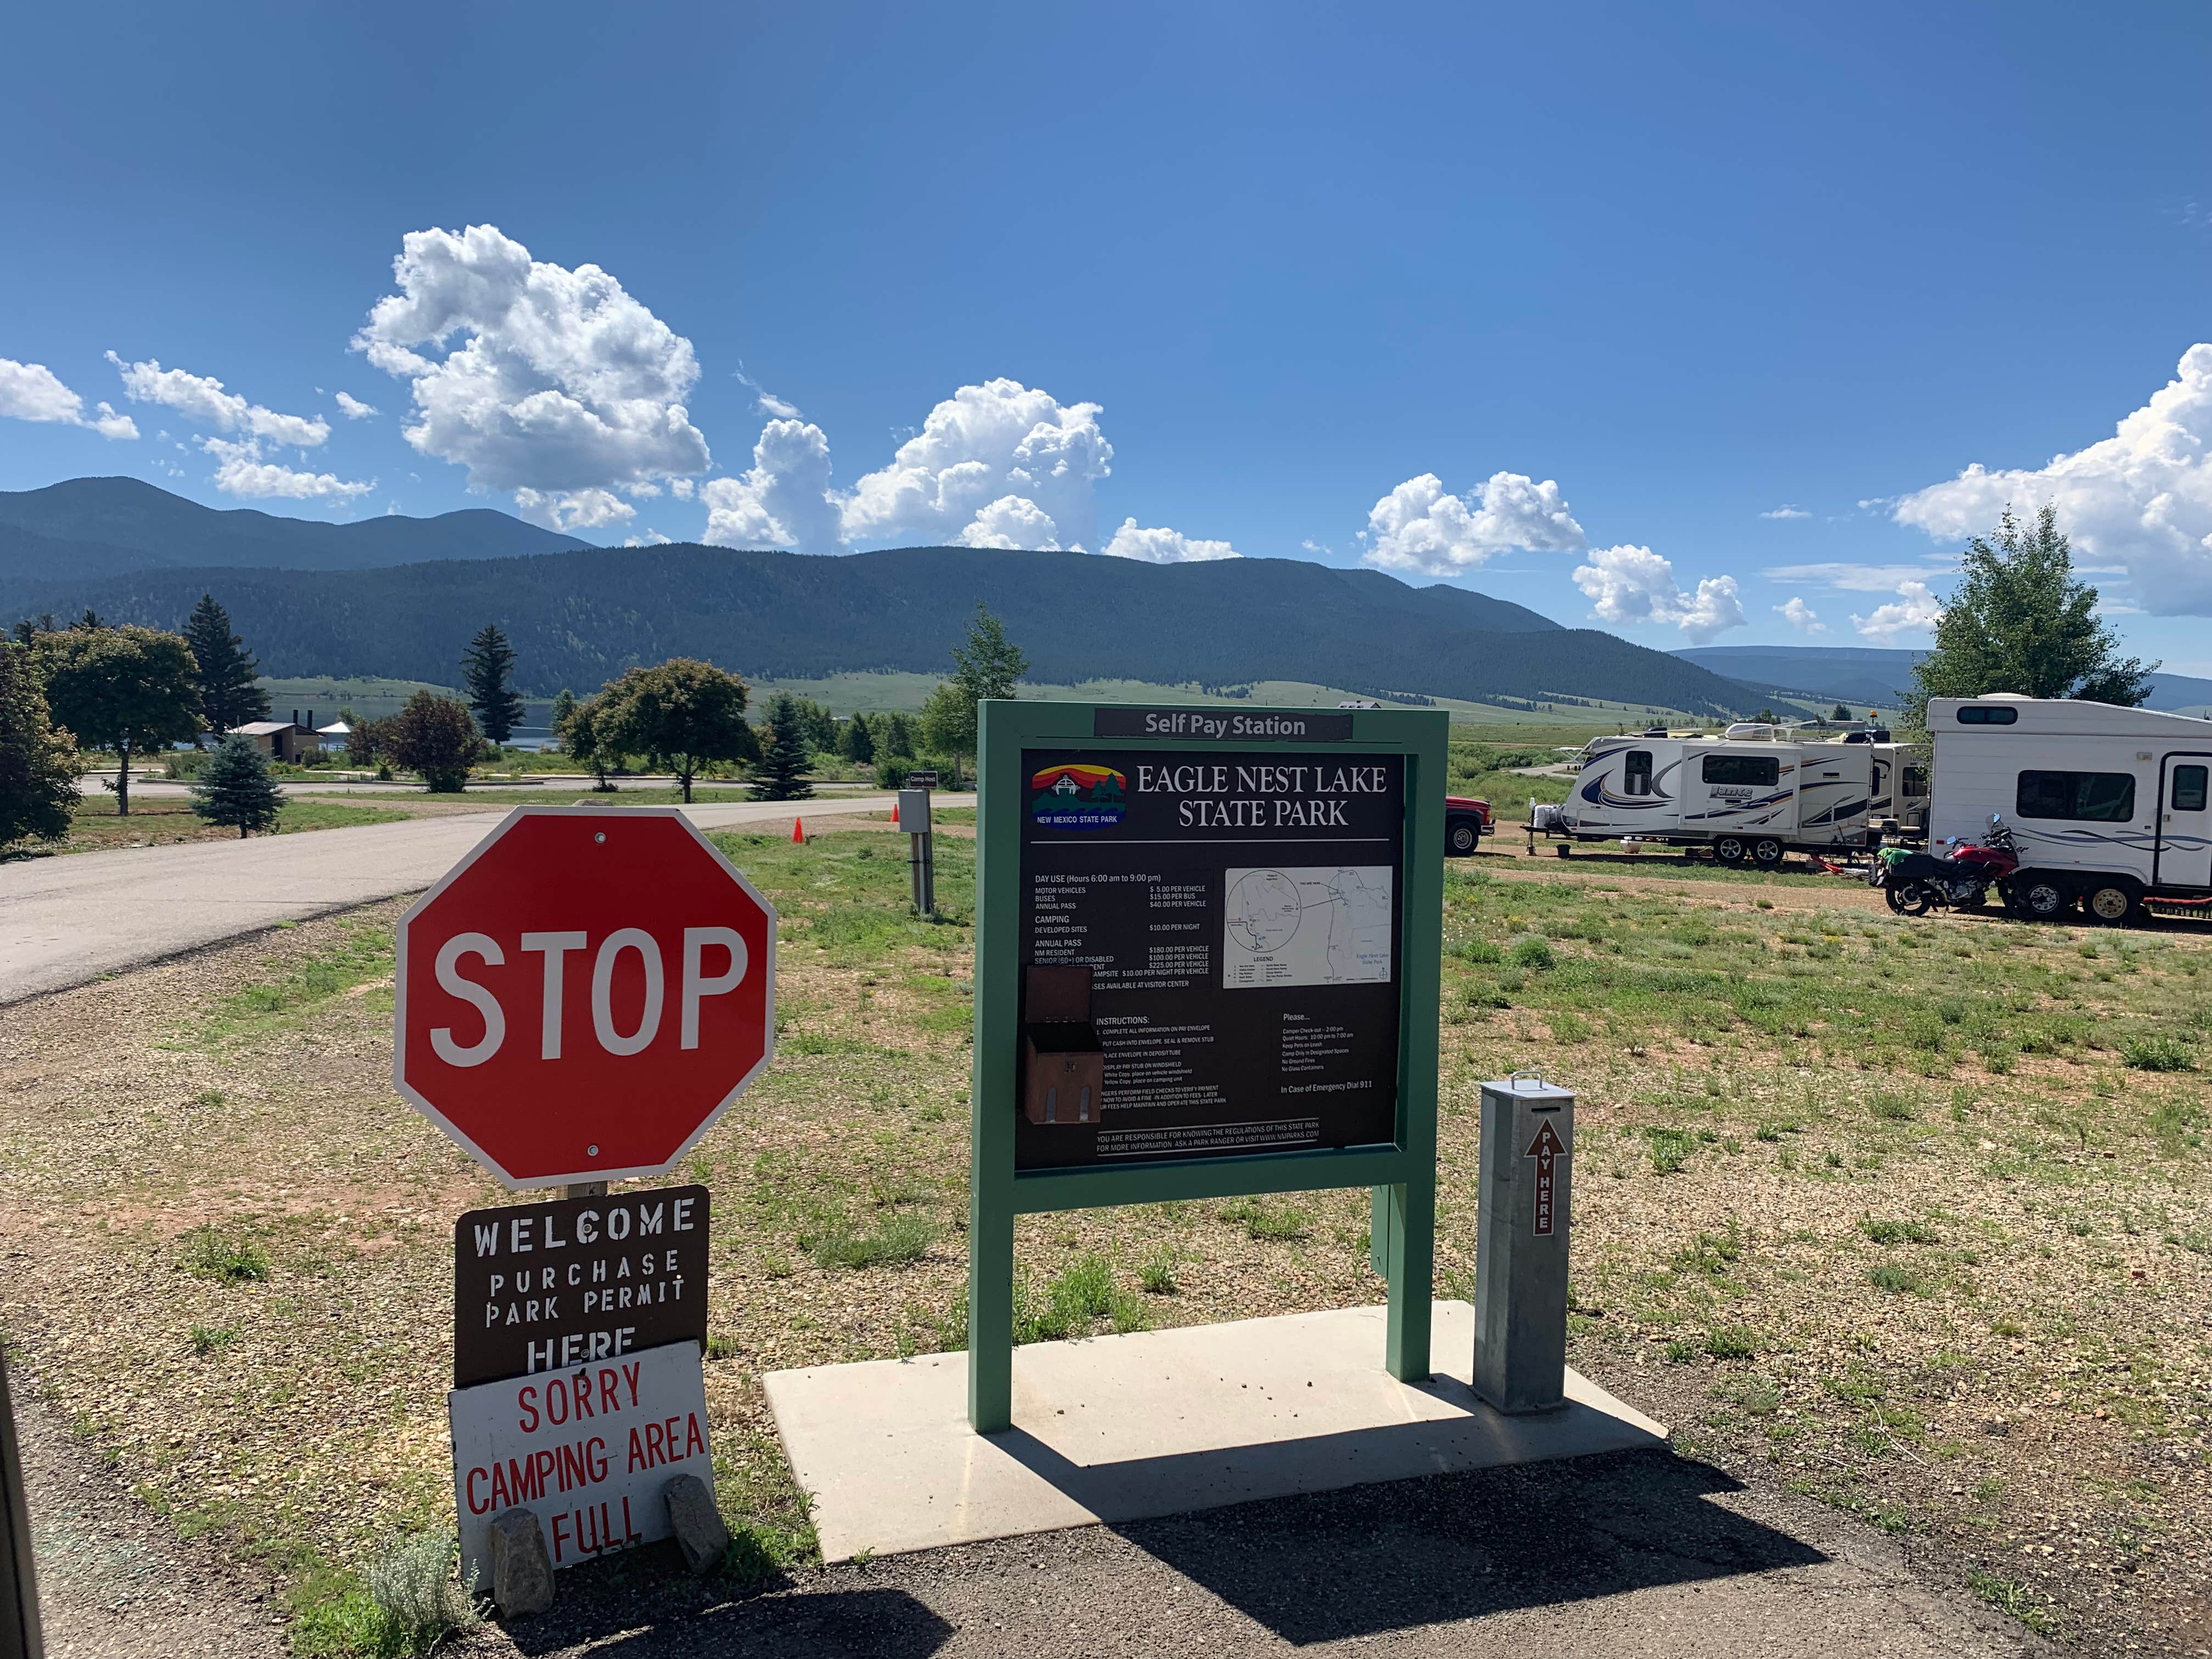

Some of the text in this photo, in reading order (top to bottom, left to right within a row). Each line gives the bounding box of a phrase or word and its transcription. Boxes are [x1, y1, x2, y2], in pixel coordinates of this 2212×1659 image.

[1146, 714, 1305, 738] Self Pay Station
[1137, 766, 1387, 793] EAGLE NEST LAKE
[1179, 800, 1349, 827] STATE PARK
[1148, 874, 1161, 883] pm)
[430, 927, 748, 1067] STOP
[1097, 1017, 1150, 1025] INSTRUCTIONS:
[1313, 1083, 1345, 1092] Emergency
[1125, 1132, 1167, 1141] RESPONSIBLE
[1183, 1129, 1212, 1137] KNOWING
[1225, 1126, 1265, 1135] REGULATIONS
[1539, 1132, 1550, 1228] PAY HERE
[475, 1198, 695, 1257] WELCOME
[490, 1250, 678, 1296] PURCHASE
[486, 1280, 684, 1328] PARK PERMIT
[518, 1361, 640, 1433] SORRY
[467, 1412, 704, 1515] CAMPING AREA
[552, 1497, 642, 1562] FULL
